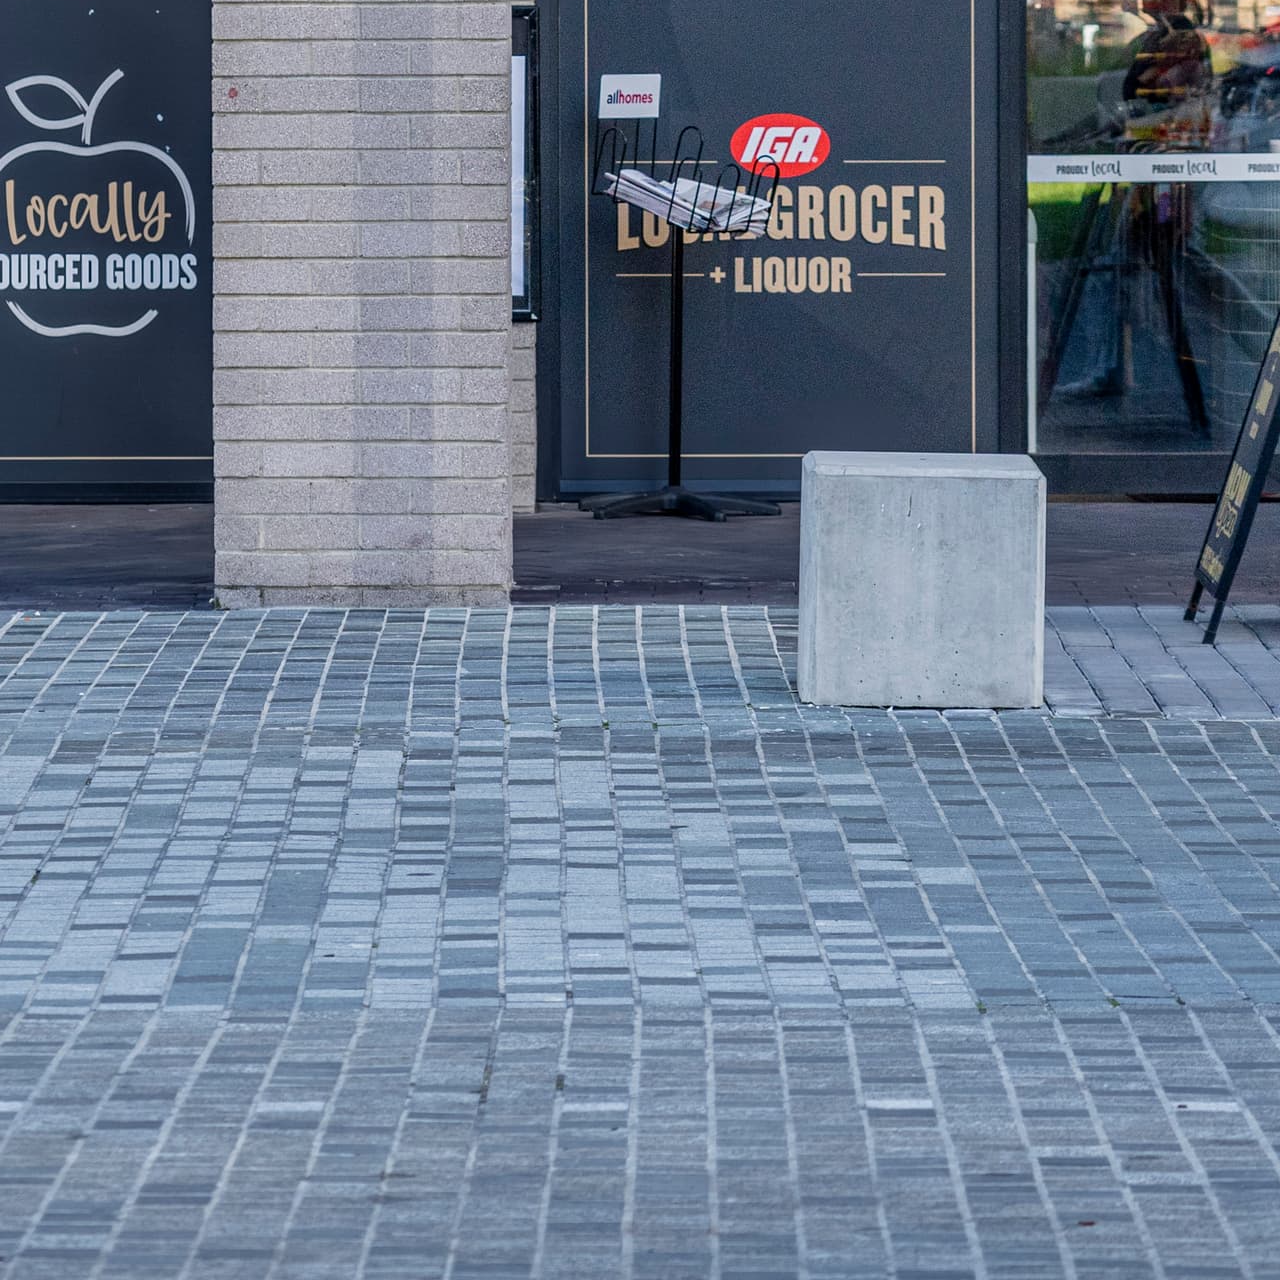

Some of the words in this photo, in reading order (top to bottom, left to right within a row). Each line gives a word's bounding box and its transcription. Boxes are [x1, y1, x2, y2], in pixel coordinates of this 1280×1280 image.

[606, 91, 654, 105] allhomes
[739, 126, 822, 163] IGA
[1056, 165, 1089, 175] PROUDLY
[1091, 160, 1122, 176] local
[1152, 164, 1184, 175] PROUDLY
[1187, 159, 1218, 175] local
[1248, 163, 1280, 173] PROUDLY
[5, 179, 171, 245] Locally
[766, 184, 947, 251] GROCER
[105, 253, 197, 290] GOODS
[734, 257, 852, 293] LIQUOR
